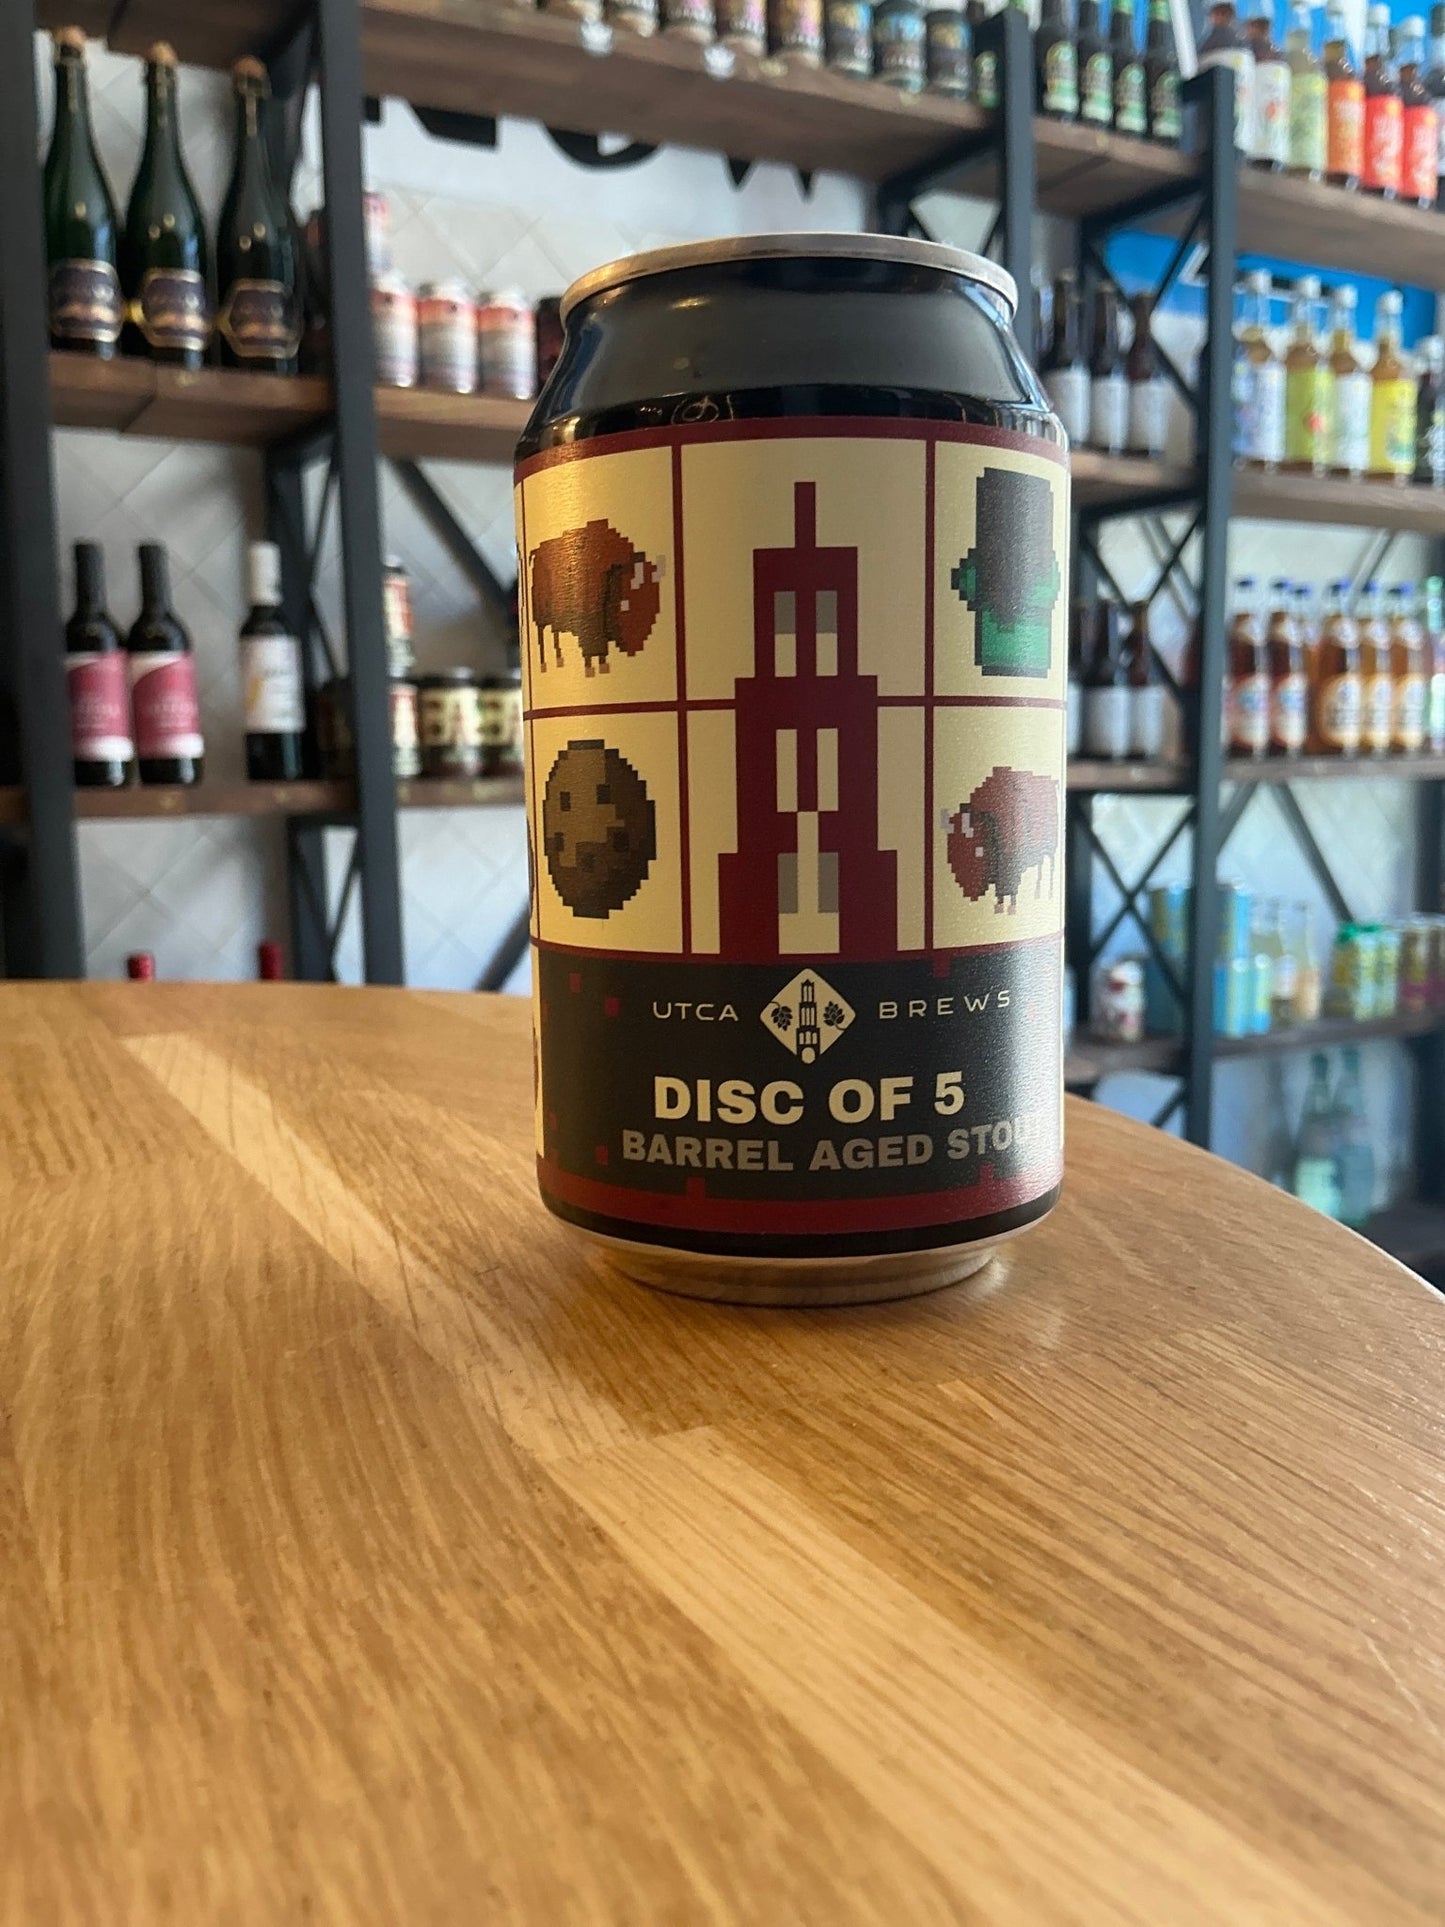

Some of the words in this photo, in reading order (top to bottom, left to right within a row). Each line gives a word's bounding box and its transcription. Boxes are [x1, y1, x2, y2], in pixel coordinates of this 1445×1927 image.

[652, 1001, 739, 1022] UTCA
[879, 990, 1011, 1019] BREWS
[654, 1076, 804, 1125] DISC
[828, 1077, 914, 1122] OF
[933, 1071, 966, 1116] 5
[622, 1129, 795, 1172] BARREL
[808, 1134, 934, 1171] AGED
